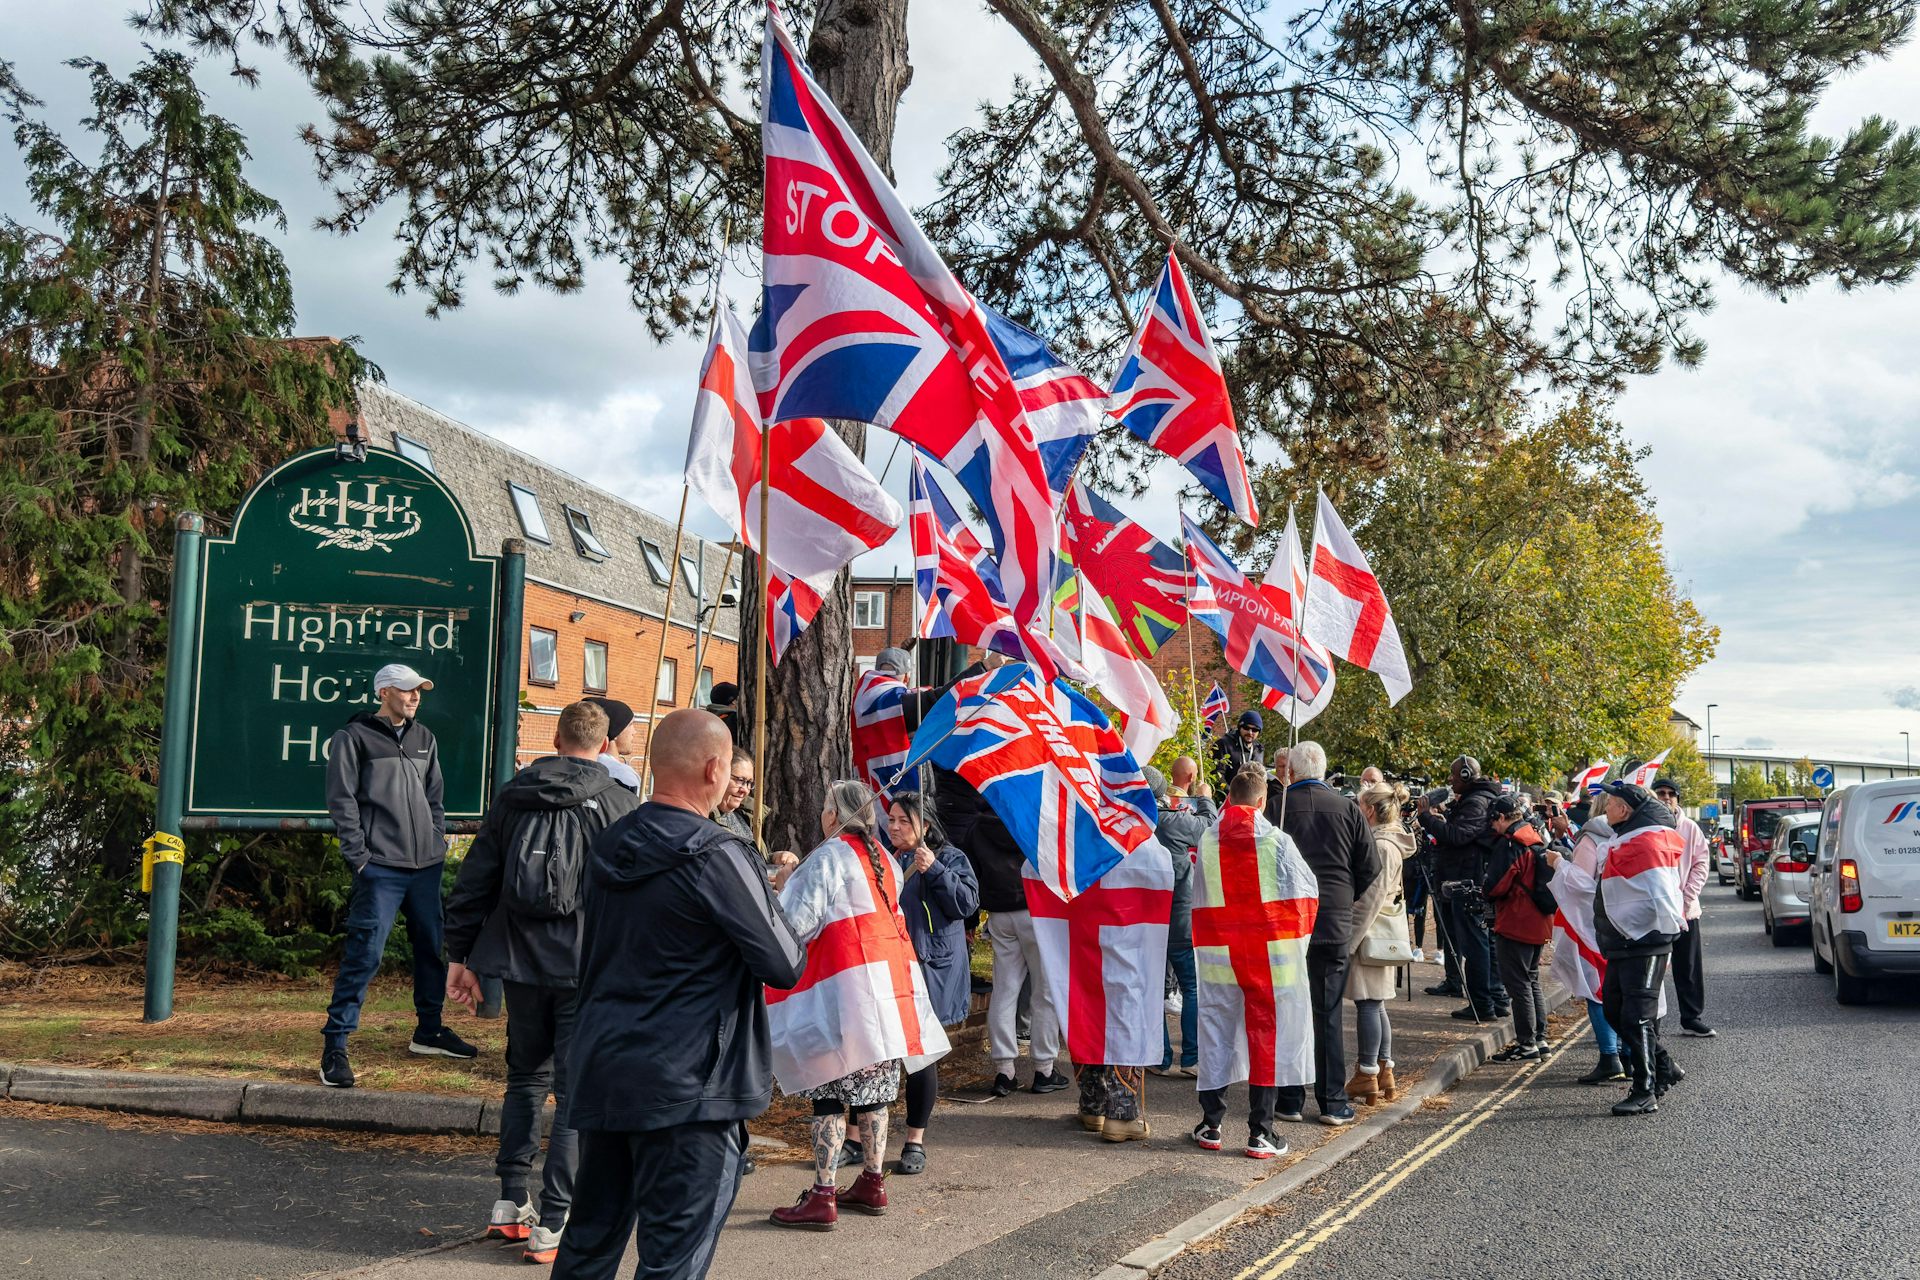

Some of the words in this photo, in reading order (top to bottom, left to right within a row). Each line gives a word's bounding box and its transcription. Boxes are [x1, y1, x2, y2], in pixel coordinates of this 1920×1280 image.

[786, 179, 903, 268] STOP
[1213, 585, 1269, 620] MPTON
[244, 603, 454, 653] Highfield
[1026, 710, 1081, 758] THE
